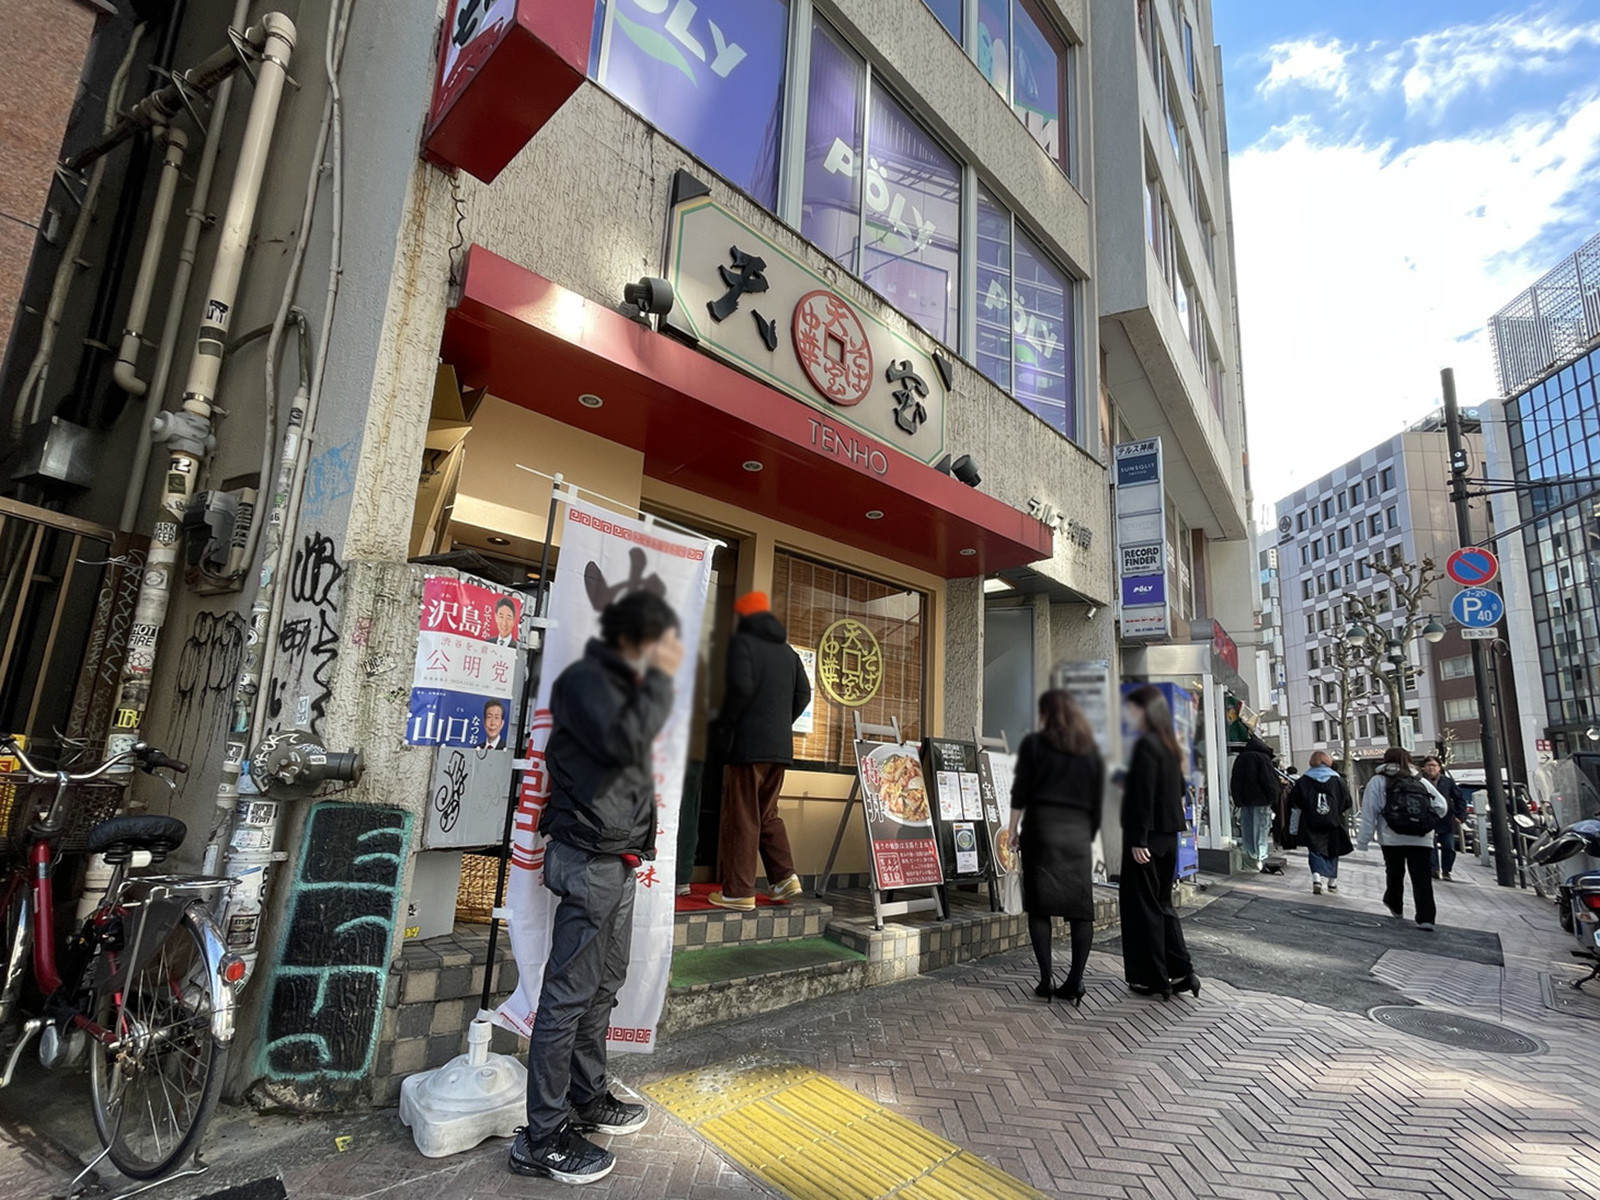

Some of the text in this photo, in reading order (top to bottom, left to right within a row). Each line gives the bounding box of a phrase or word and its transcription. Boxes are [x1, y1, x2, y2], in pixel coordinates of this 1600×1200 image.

[807, 417, 889, 476] TENHO
[1124, 546, 1159, 559] RECORD
[1125, 556, 1157, 567] FINDER
[1465, 590, 1487, 598] 7-20
[427, 598, 482, 637] 沢島
[1462, 597, 1483, 622] P
[1477, 609, 1493, 622] 40
[130, 625, 156, 637] HOT
[129, 635, 154, 647] FIRE
[426, 649, 509, 684] 公明党
[412, 711, 470, 744] 山口
[468, 714, 481, 745] なつお
